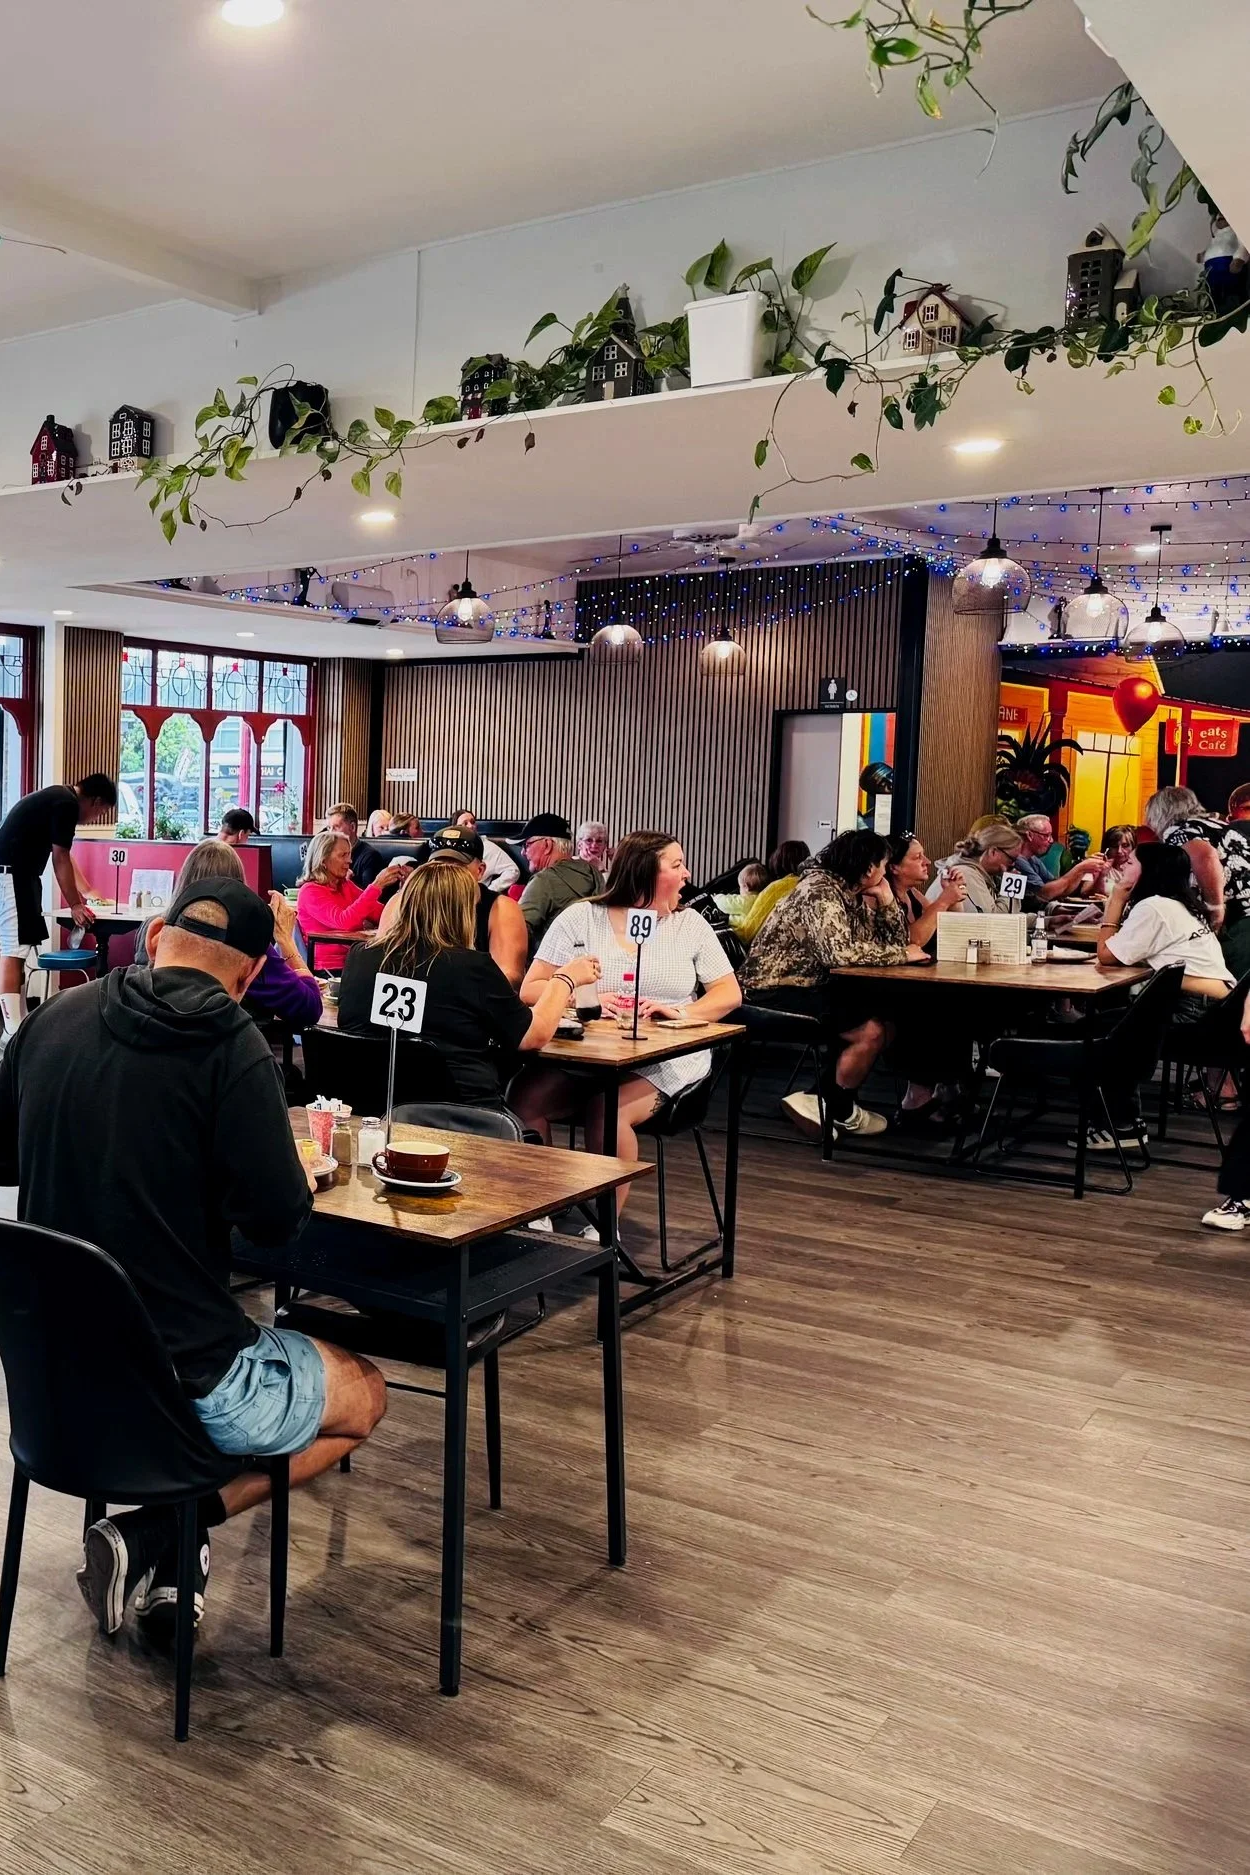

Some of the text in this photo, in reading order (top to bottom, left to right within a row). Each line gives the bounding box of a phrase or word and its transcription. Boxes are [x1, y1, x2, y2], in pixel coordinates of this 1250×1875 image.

[1199, 726, 1228, 739] eats
[1198, 740, 1227, 750] Café
[111, 849, 126, 863] 30
[1004, 877, 1022, 895] 29
[630, 914, 652, 938] 89
[378, 982, 417, 1022] 23
